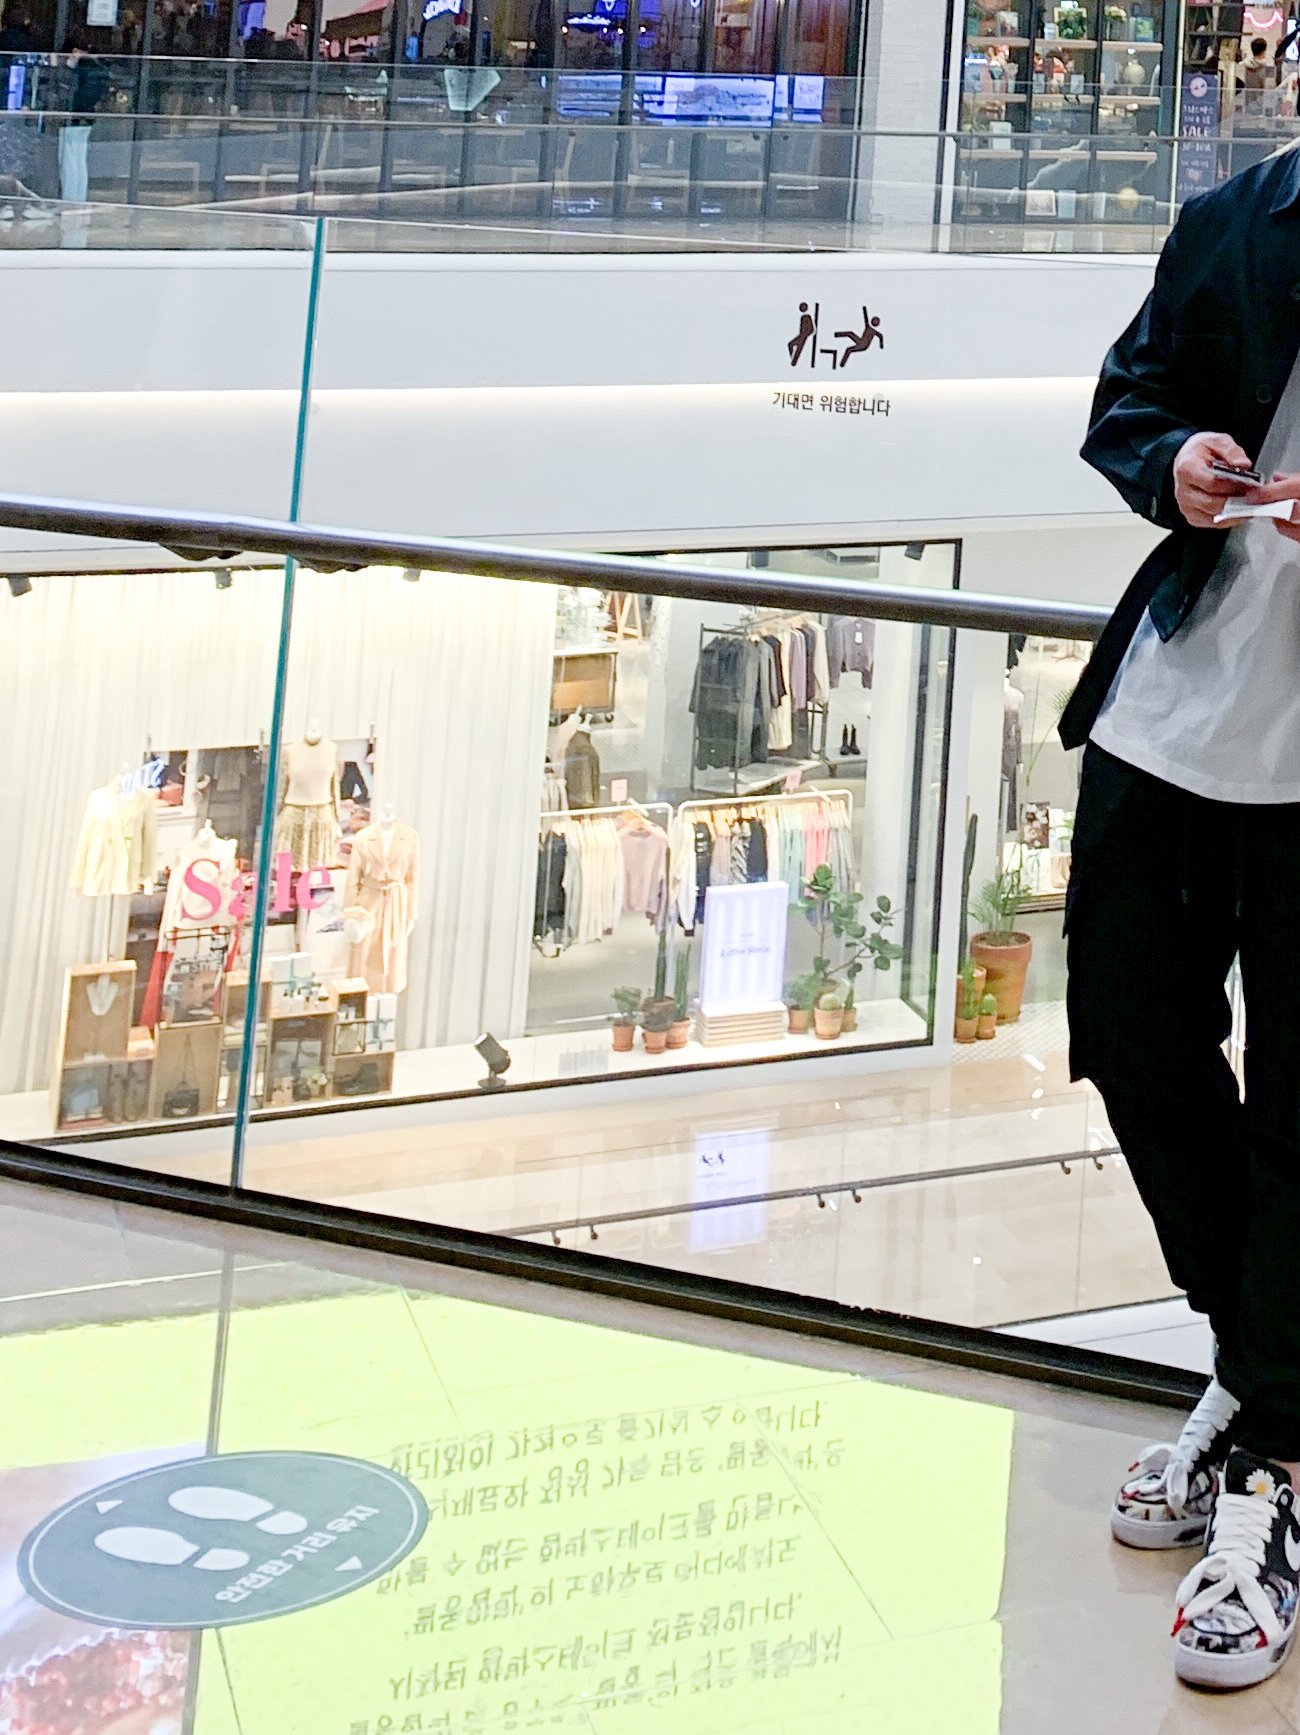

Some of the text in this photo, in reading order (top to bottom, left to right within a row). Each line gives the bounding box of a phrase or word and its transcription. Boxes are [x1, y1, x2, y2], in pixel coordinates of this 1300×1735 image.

[773, 392, 891, 417] 기대면 위험합니다
[180, 852, 334, 921] Sale
[215, 1504, 380, 1603] 안전한 거리 유지
